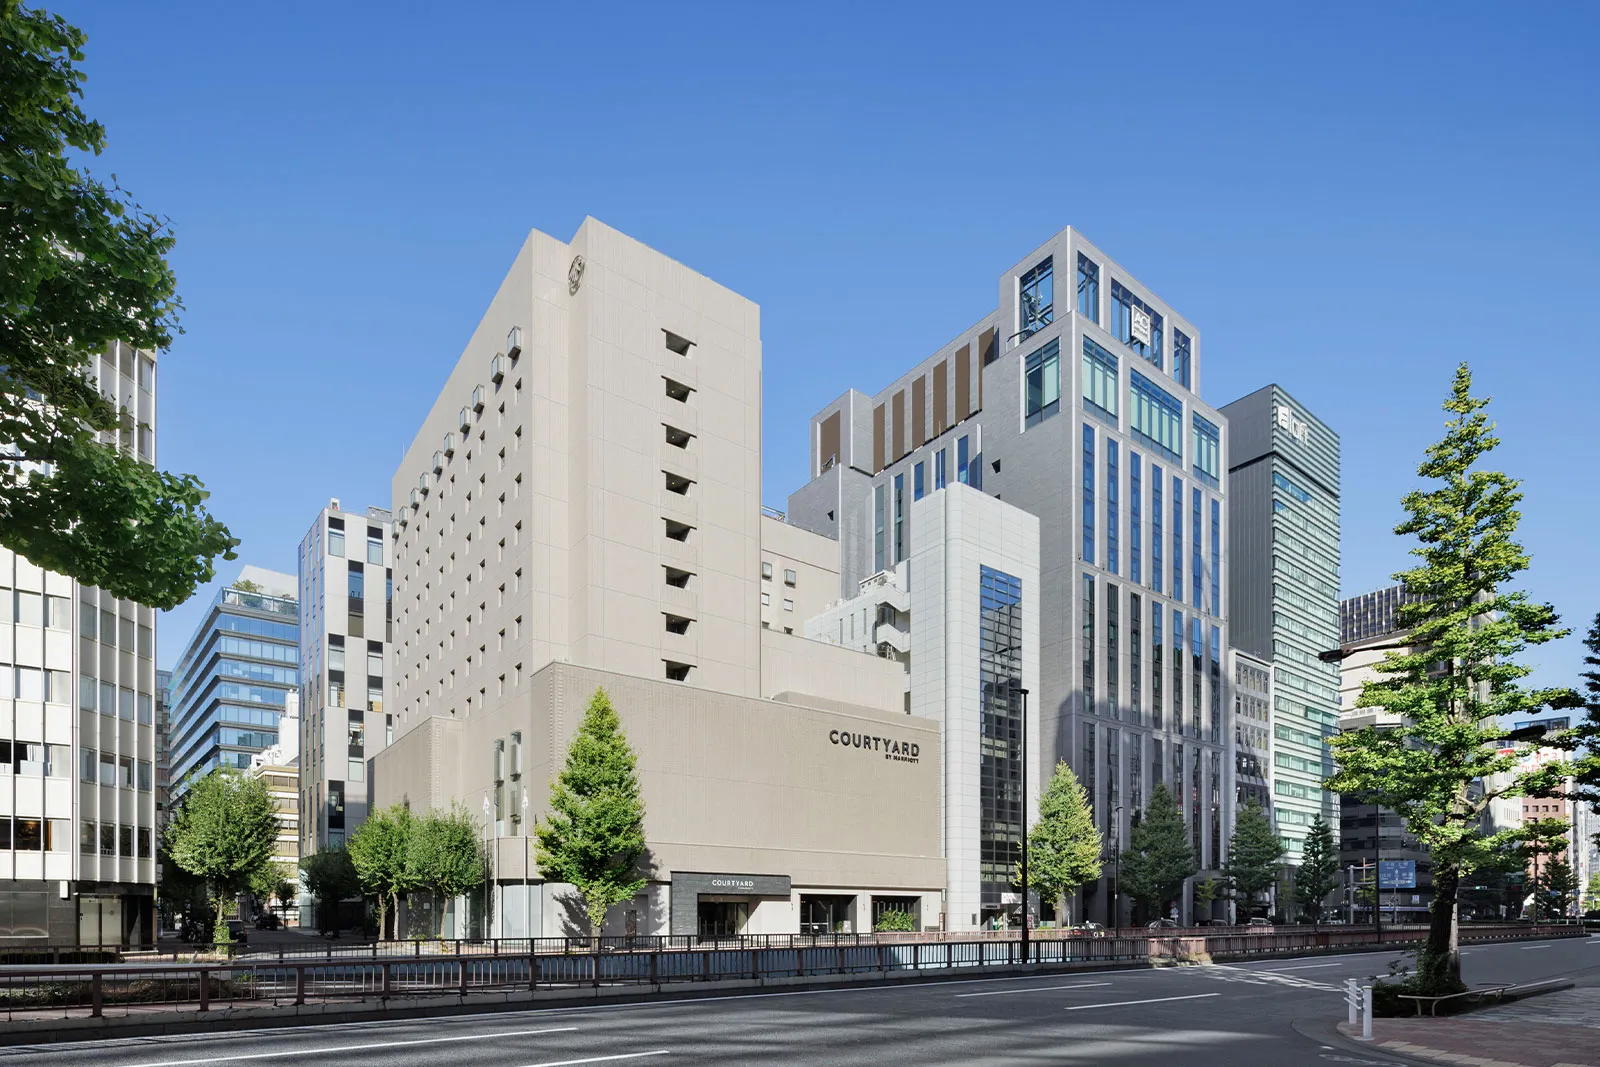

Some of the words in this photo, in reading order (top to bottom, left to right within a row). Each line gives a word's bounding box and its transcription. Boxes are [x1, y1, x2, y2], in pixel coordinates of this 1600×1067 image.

[829, 729, 920, 757] COURTYARD
[893, 755, 919, 764] MARRIOTT
[711, 879, 754, 887] COURTYARD
